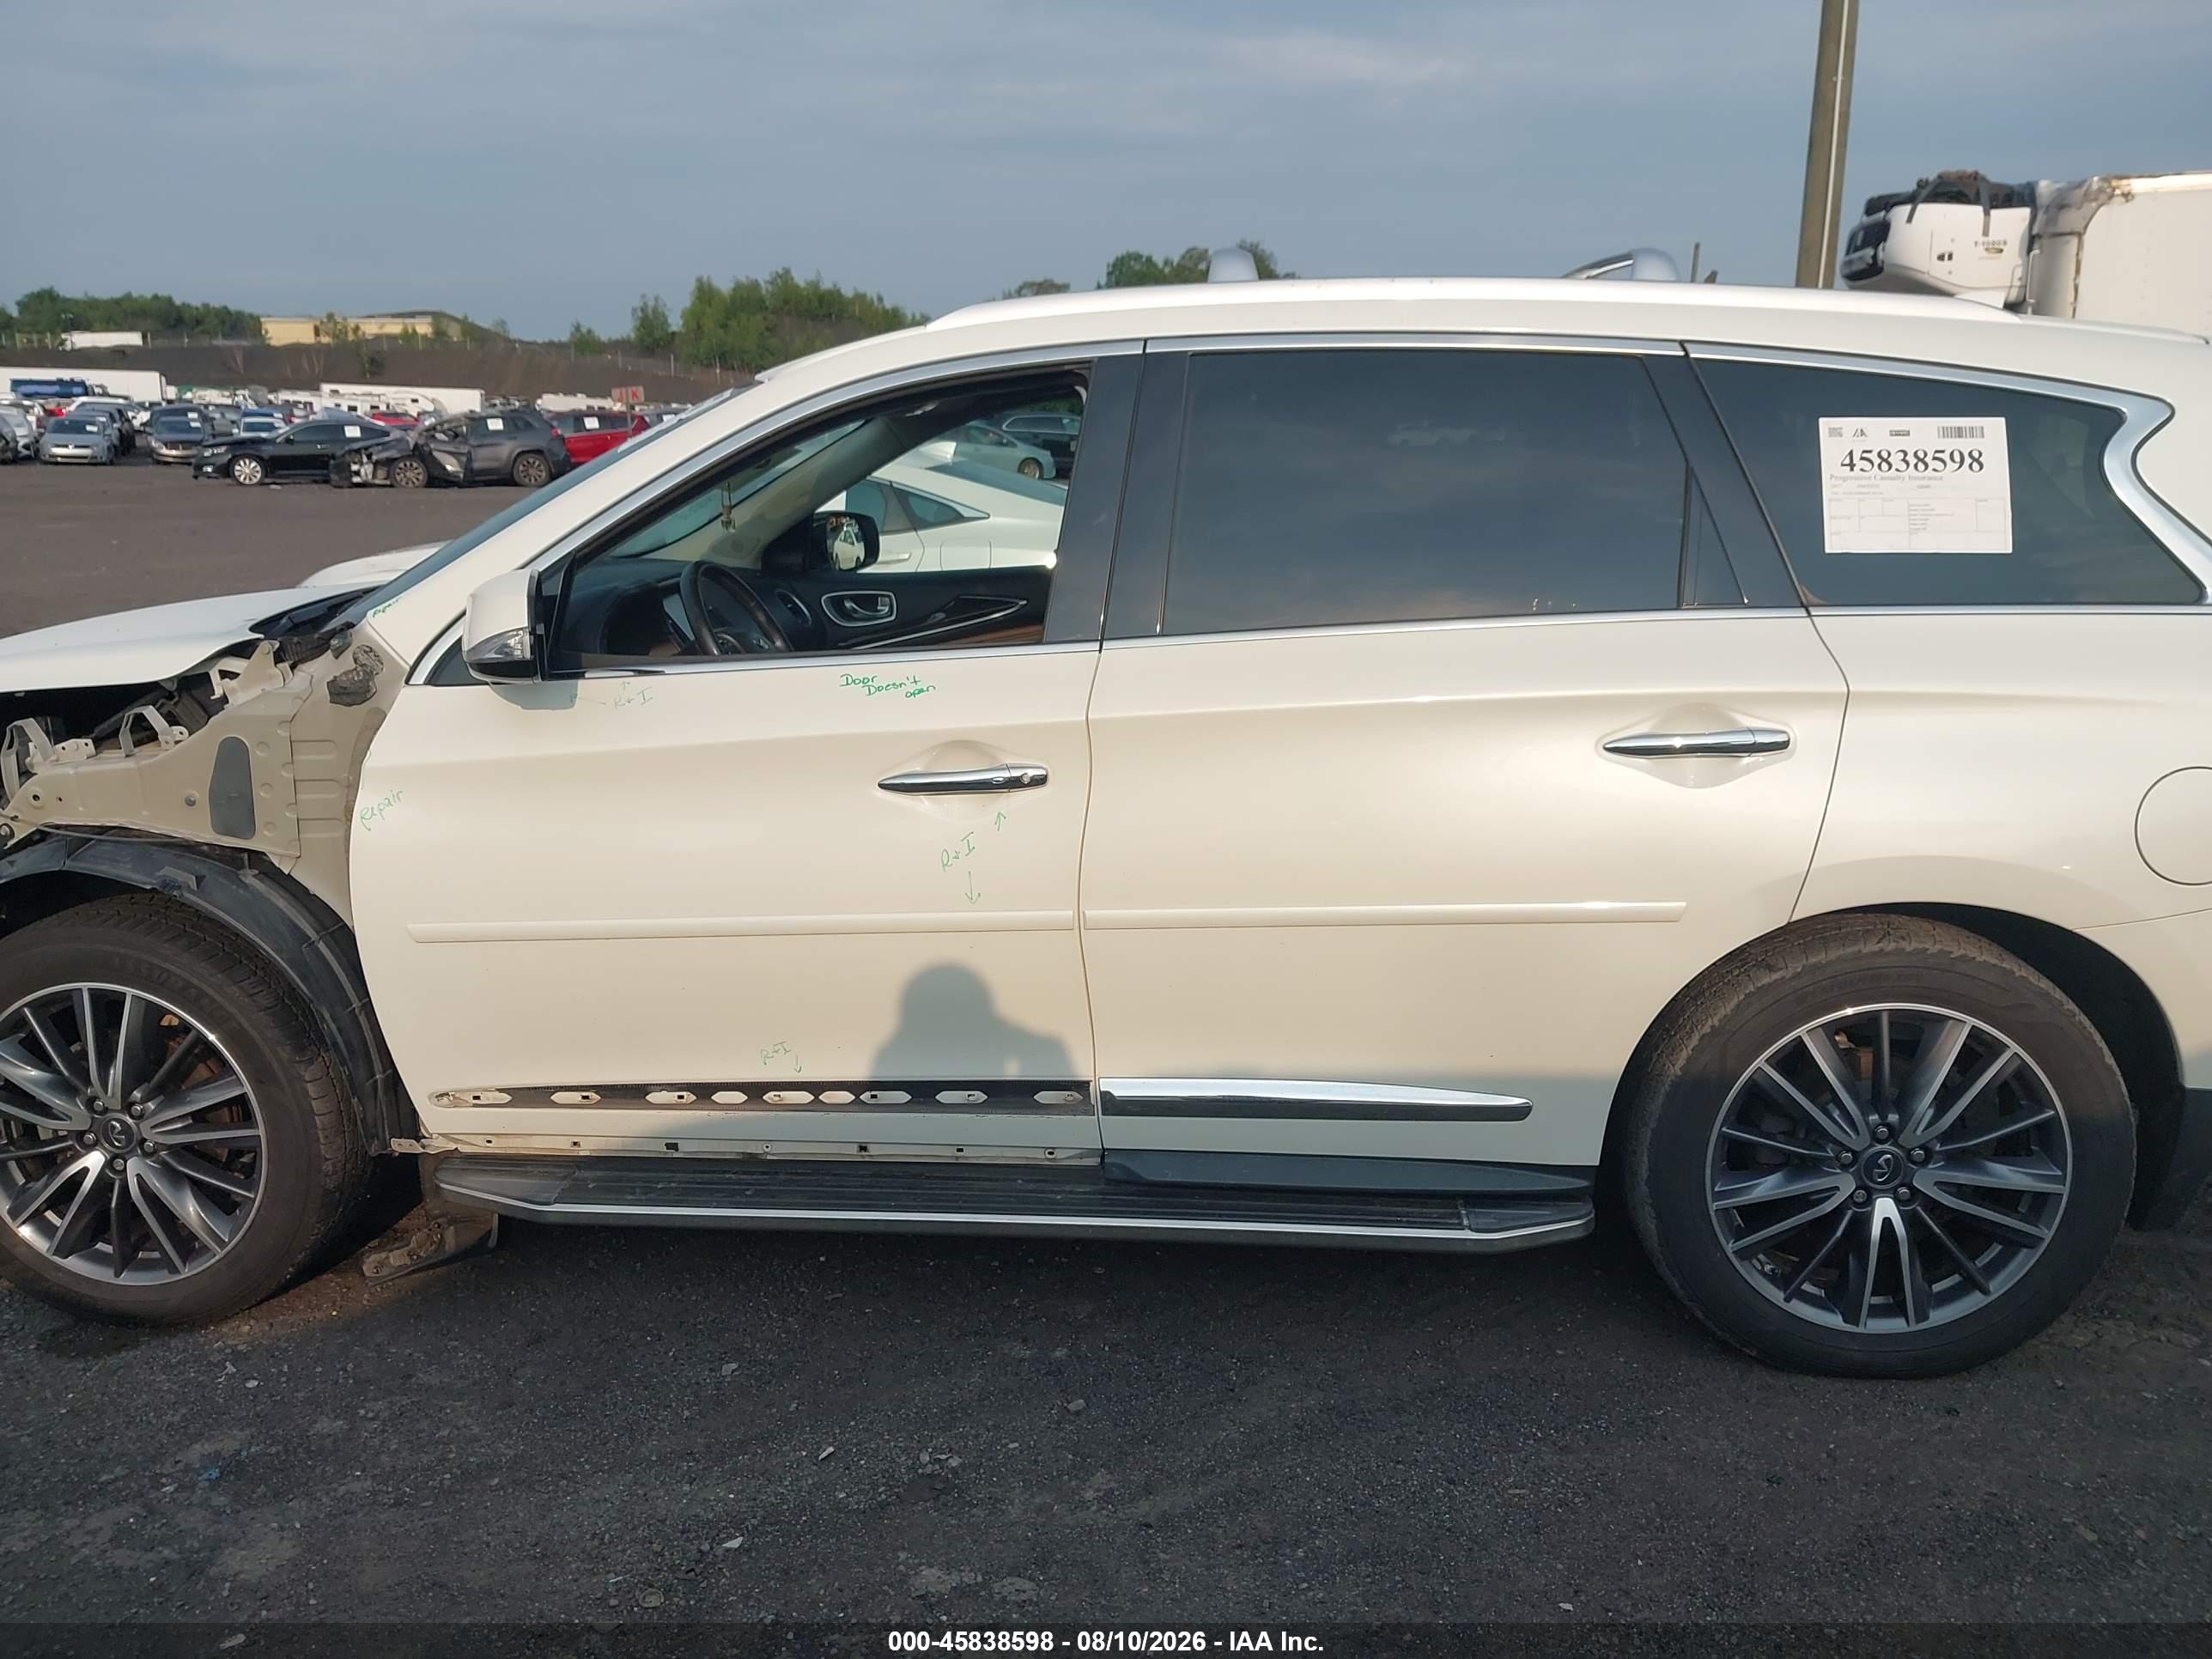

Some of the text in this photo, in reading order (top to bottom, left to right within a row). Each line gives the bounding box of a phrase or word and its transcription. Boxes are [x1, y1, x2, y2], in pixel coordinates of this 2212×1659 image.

[1840, 447, 1984, 473] 45838598
[839, 673, 878, 687] Door
[861, 675, 921, 696] Doesn't
[905, 685, 936, 698] open
